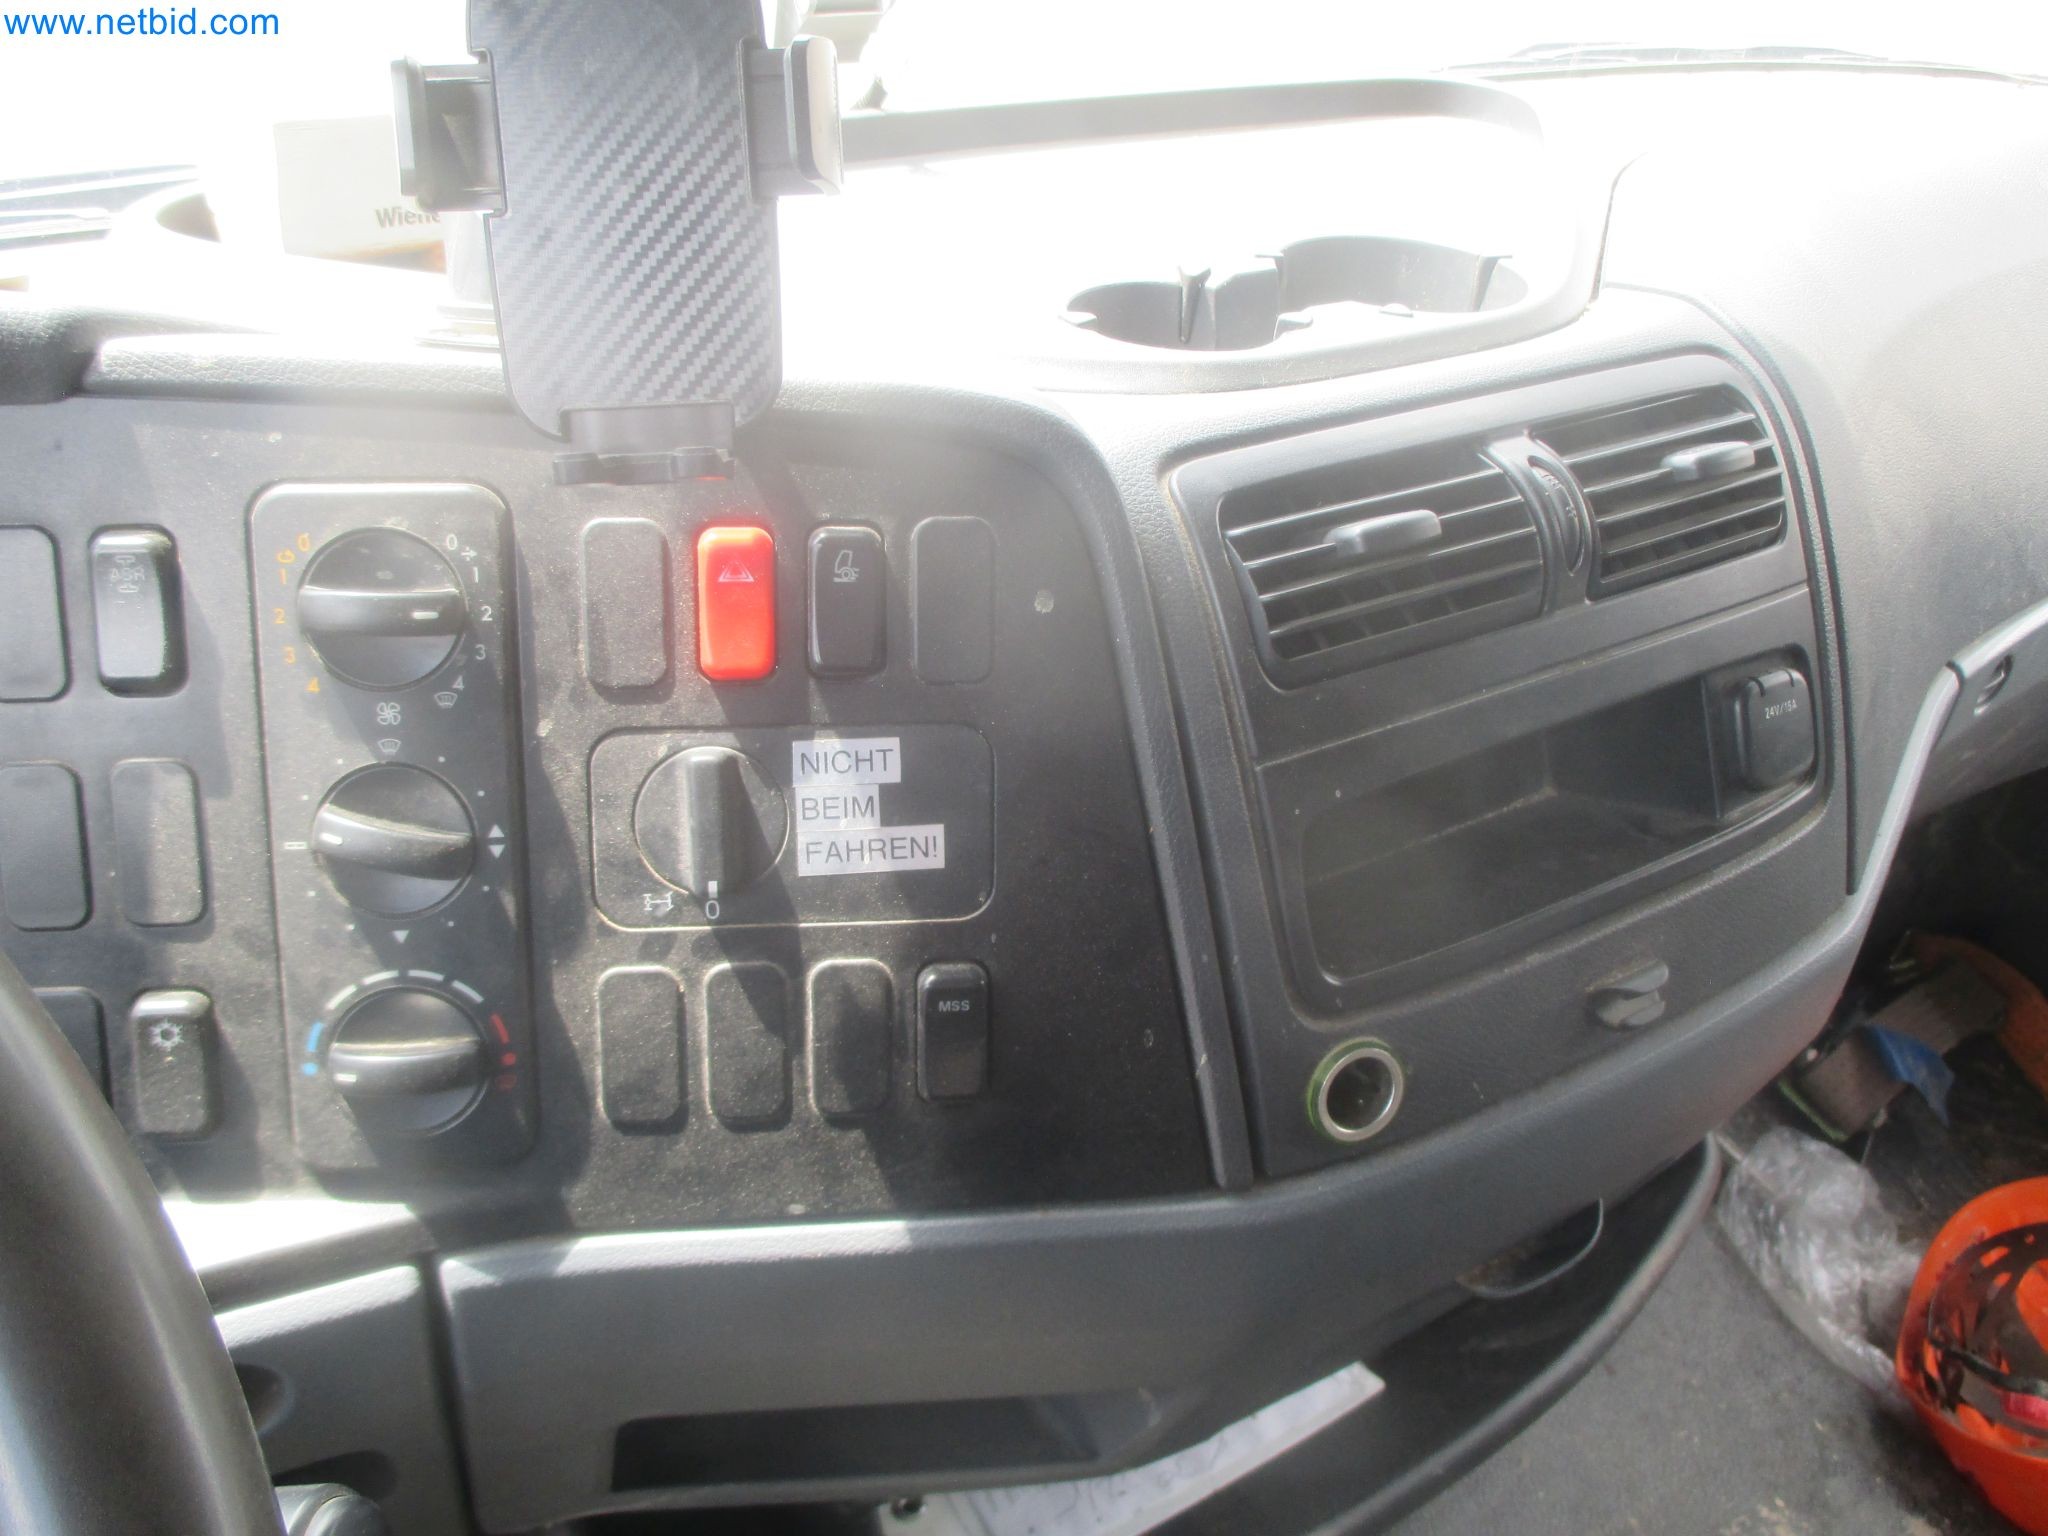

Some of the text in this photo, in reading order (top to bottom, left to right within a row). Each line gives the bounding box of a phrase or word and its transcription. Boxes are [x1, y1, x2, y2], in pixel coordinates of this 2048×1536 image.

[446, 534, 458, 551] 0
[471, 567, 479, 583] 1
[273, 608, 286, 624] 2
[481, 606, 493, 621] 2
[284, 647, 296, 664] 3
[475, 644, 486, 660] 3
[307, 677, 321, 693] 4
[452, 675, 465, 690] 4
[800, 748, 894, 776] NICHT
[801, 795, 876, 821] BEIM
[806, 835, 938, 865] FAHREN!
[705, 900, 720, 920] 0
[938, 1000, 970, 1013] MSS
